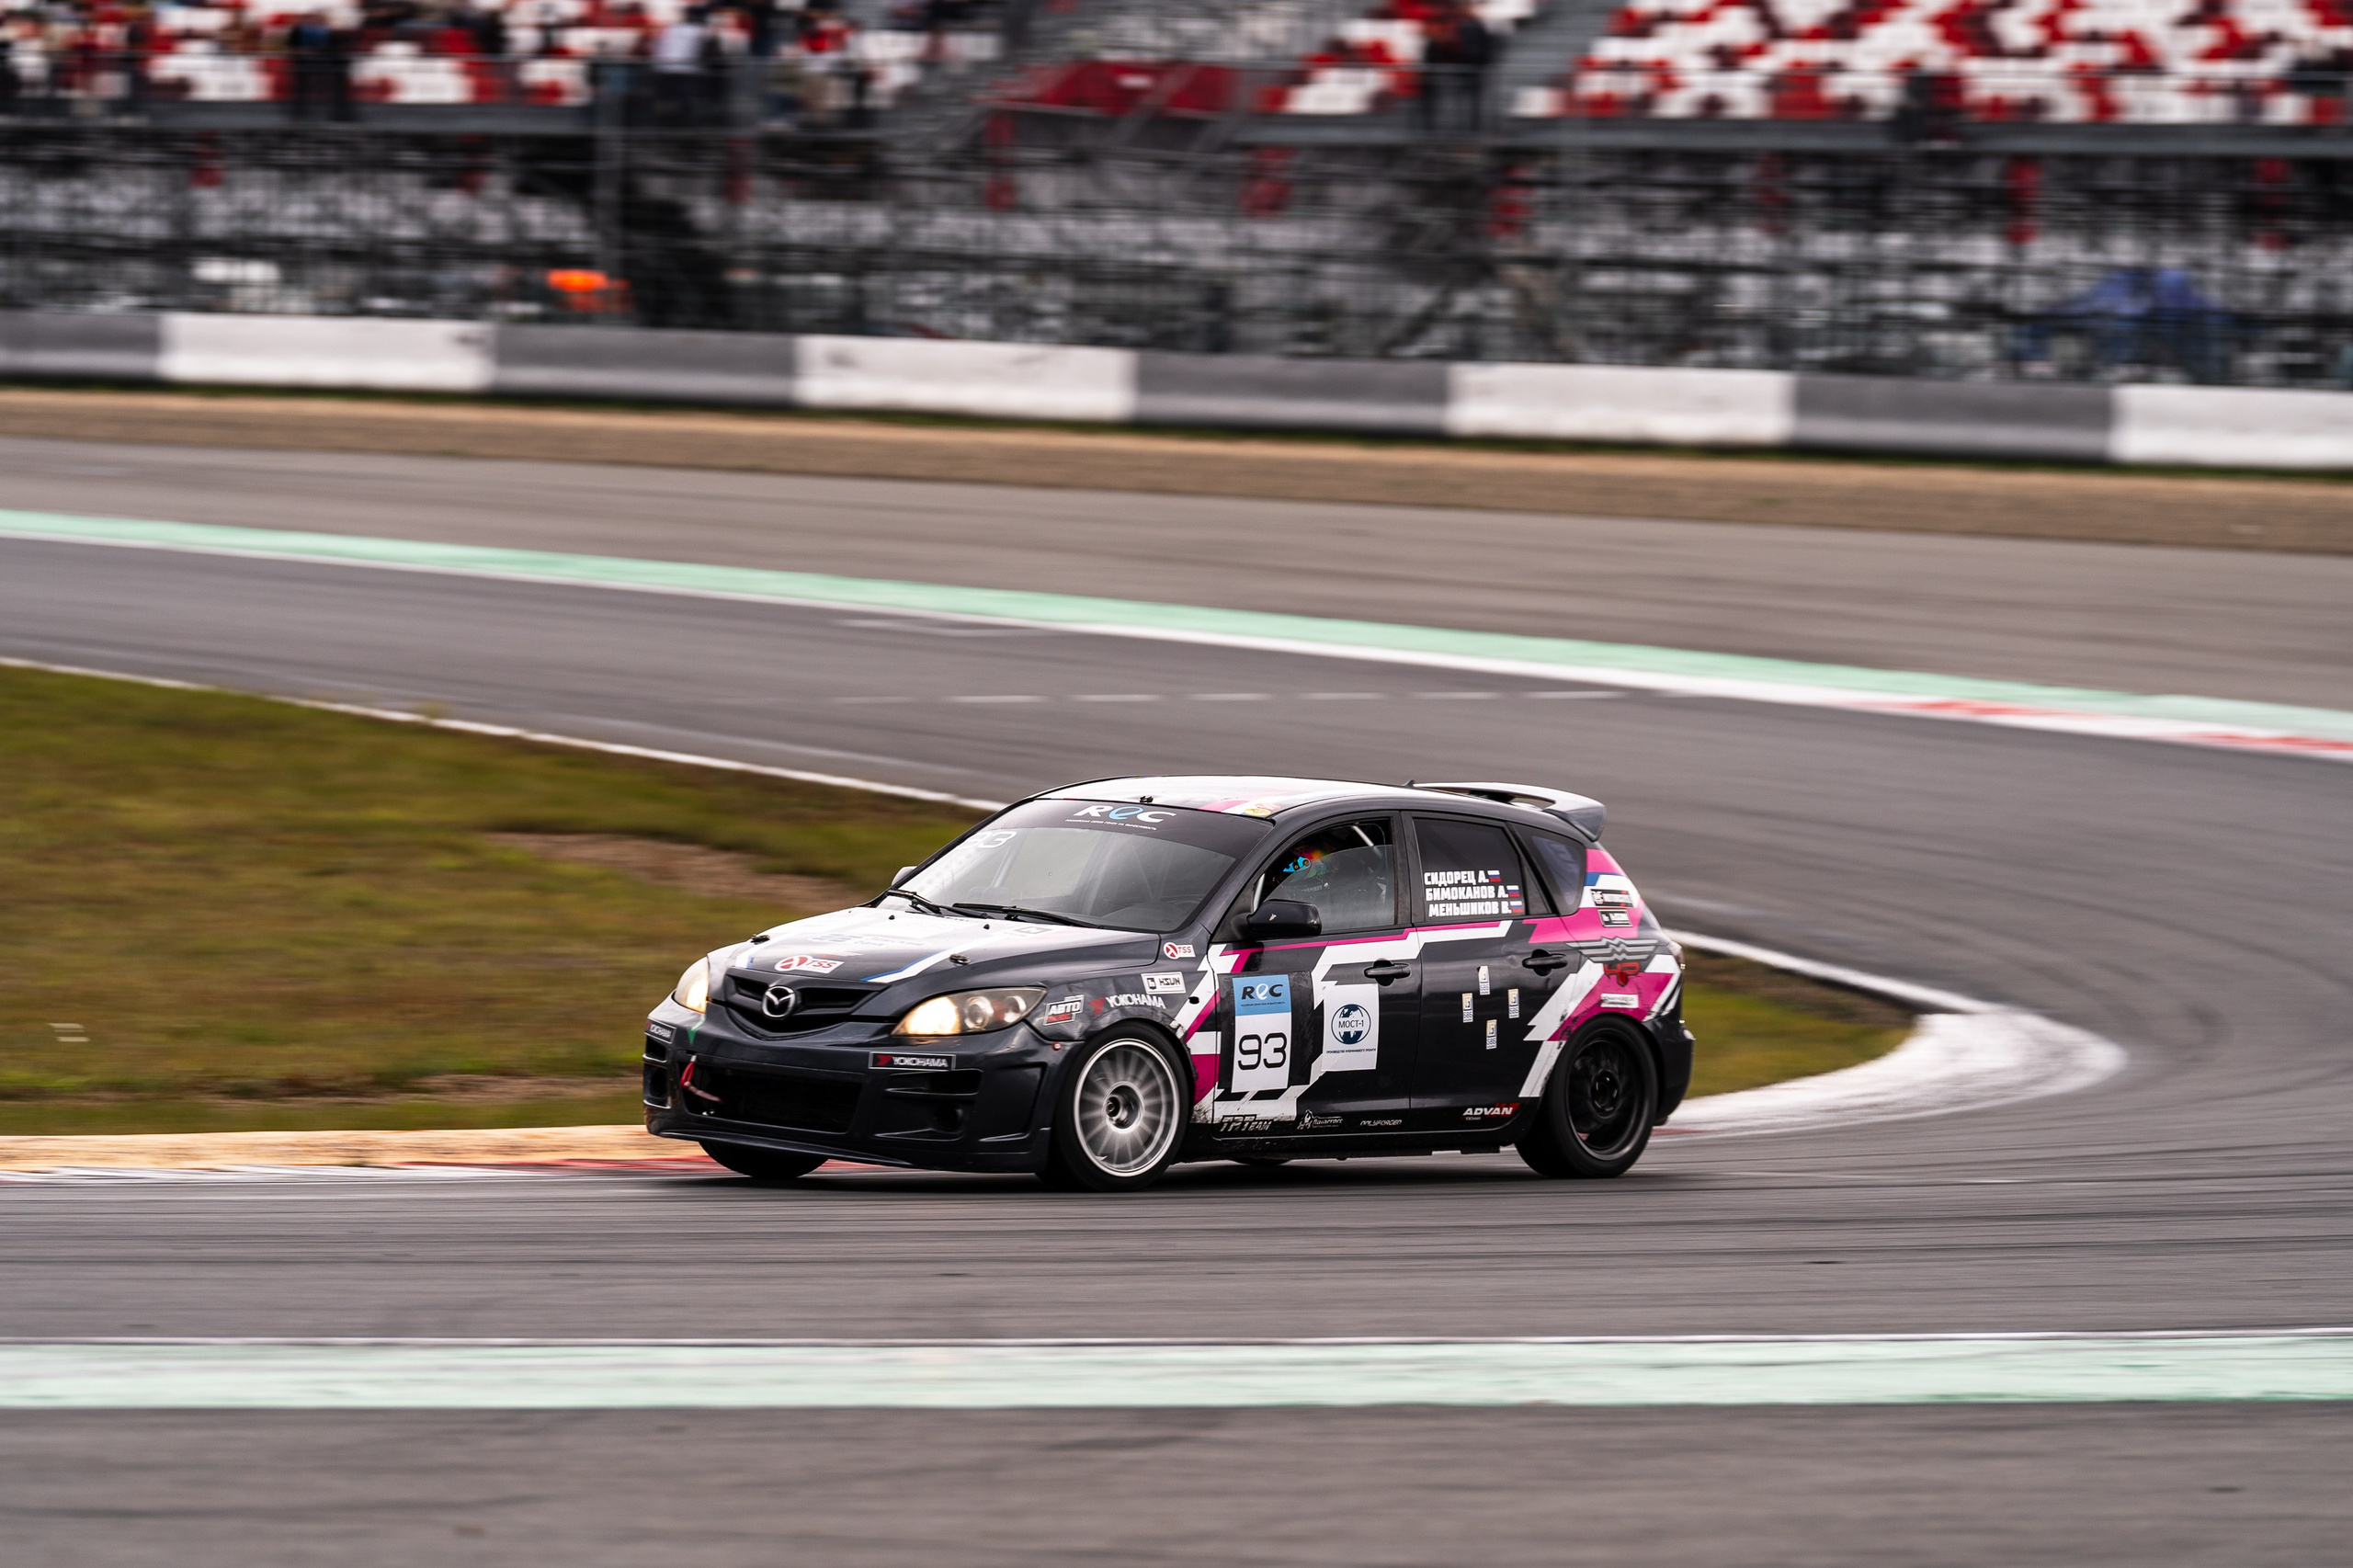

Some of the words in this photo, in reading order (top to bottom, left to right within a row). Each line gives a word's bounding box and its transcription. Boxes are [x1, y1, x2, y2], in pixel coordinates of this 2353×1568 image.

[1424, 870, 1476, 887] СИДОРЕЦ
[1425, 885, 1495, 901] БИМОКАНОВ
[1428, 901, 1499, 917] МЕНЬШИКОВ
[806, 960, 837, 969] TSS
[1048, 1001, 1082, 1016] АВТО
[1105, 994, 1166, 1009] YOKOHAMA
[1338, 1019, 1364, 1028] МОСТ-1
[1238, 1032, 1287, 1070] 93
[892, 1056, 949, 1067] YOKOHAMA
[1462, 1107, 1513, 1116] ADVAN
